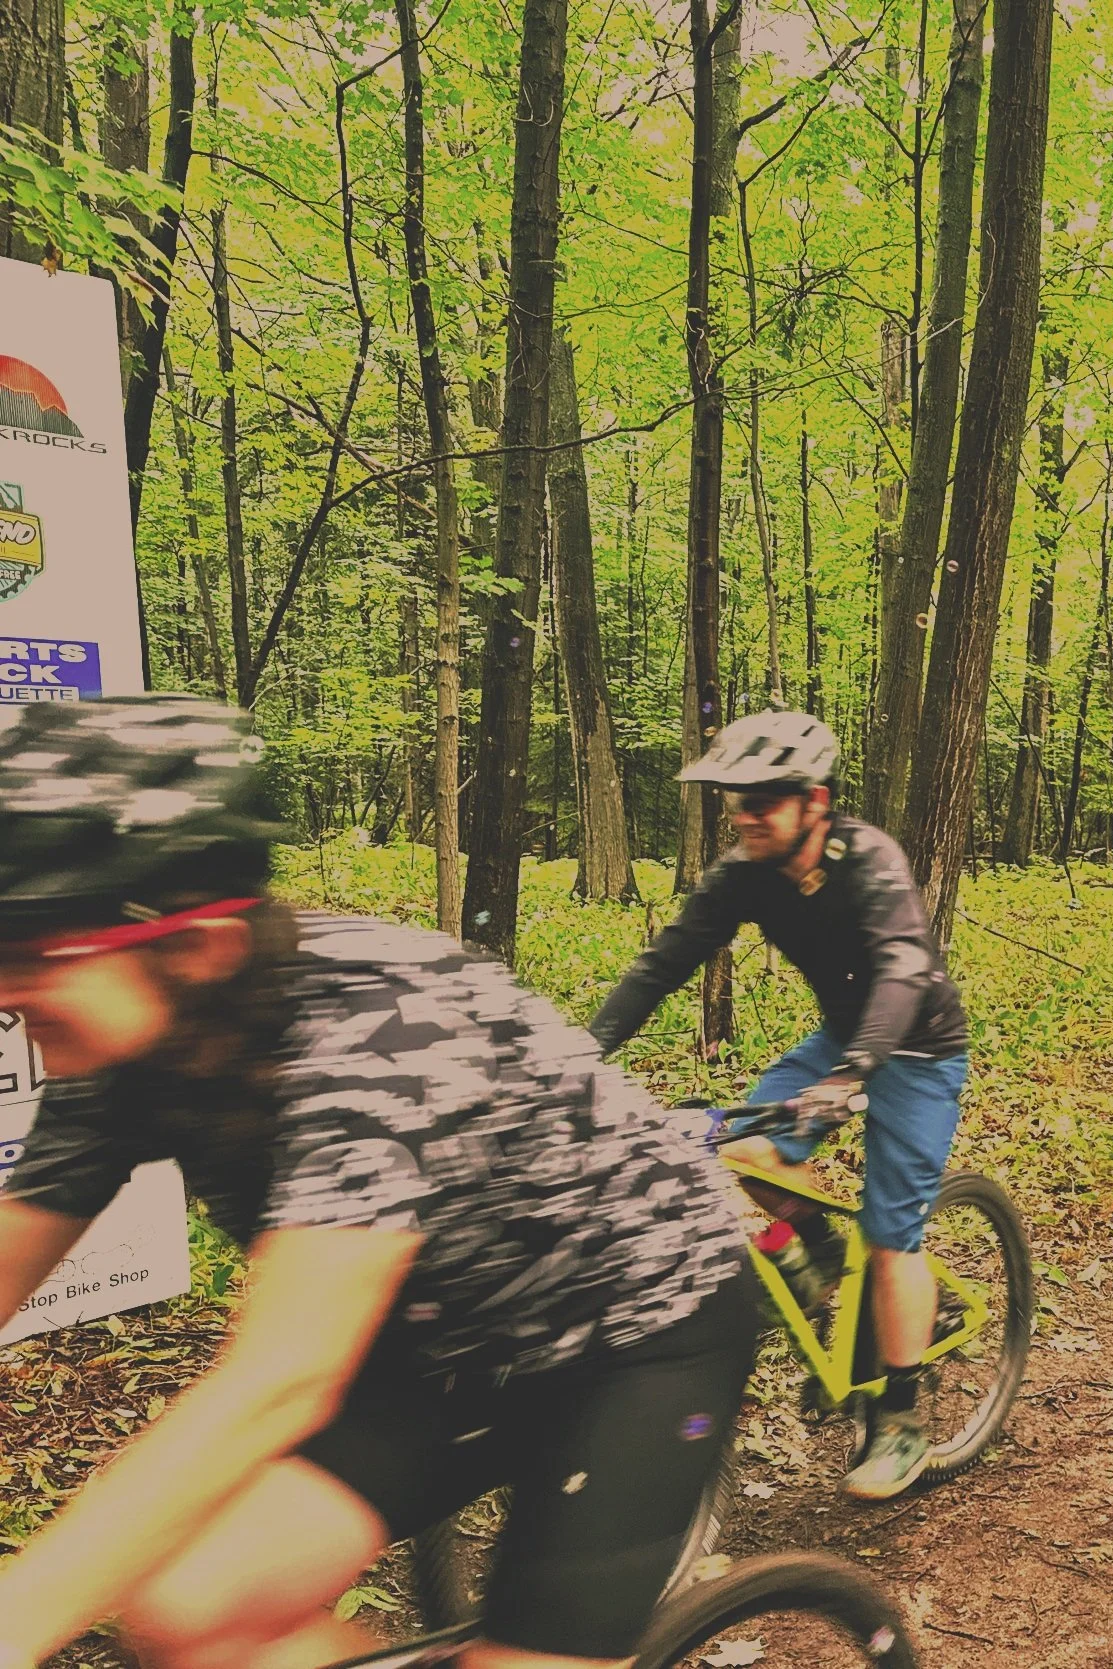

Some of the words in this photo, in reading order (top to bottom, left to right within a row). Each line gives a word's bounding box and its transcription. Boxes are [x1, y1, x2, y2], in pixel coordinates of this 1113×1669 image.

[0, 663, 62, 684] CK
[66, 1281, 101, 1299] Bike
[109, 1268, 149, 1288] Shop
